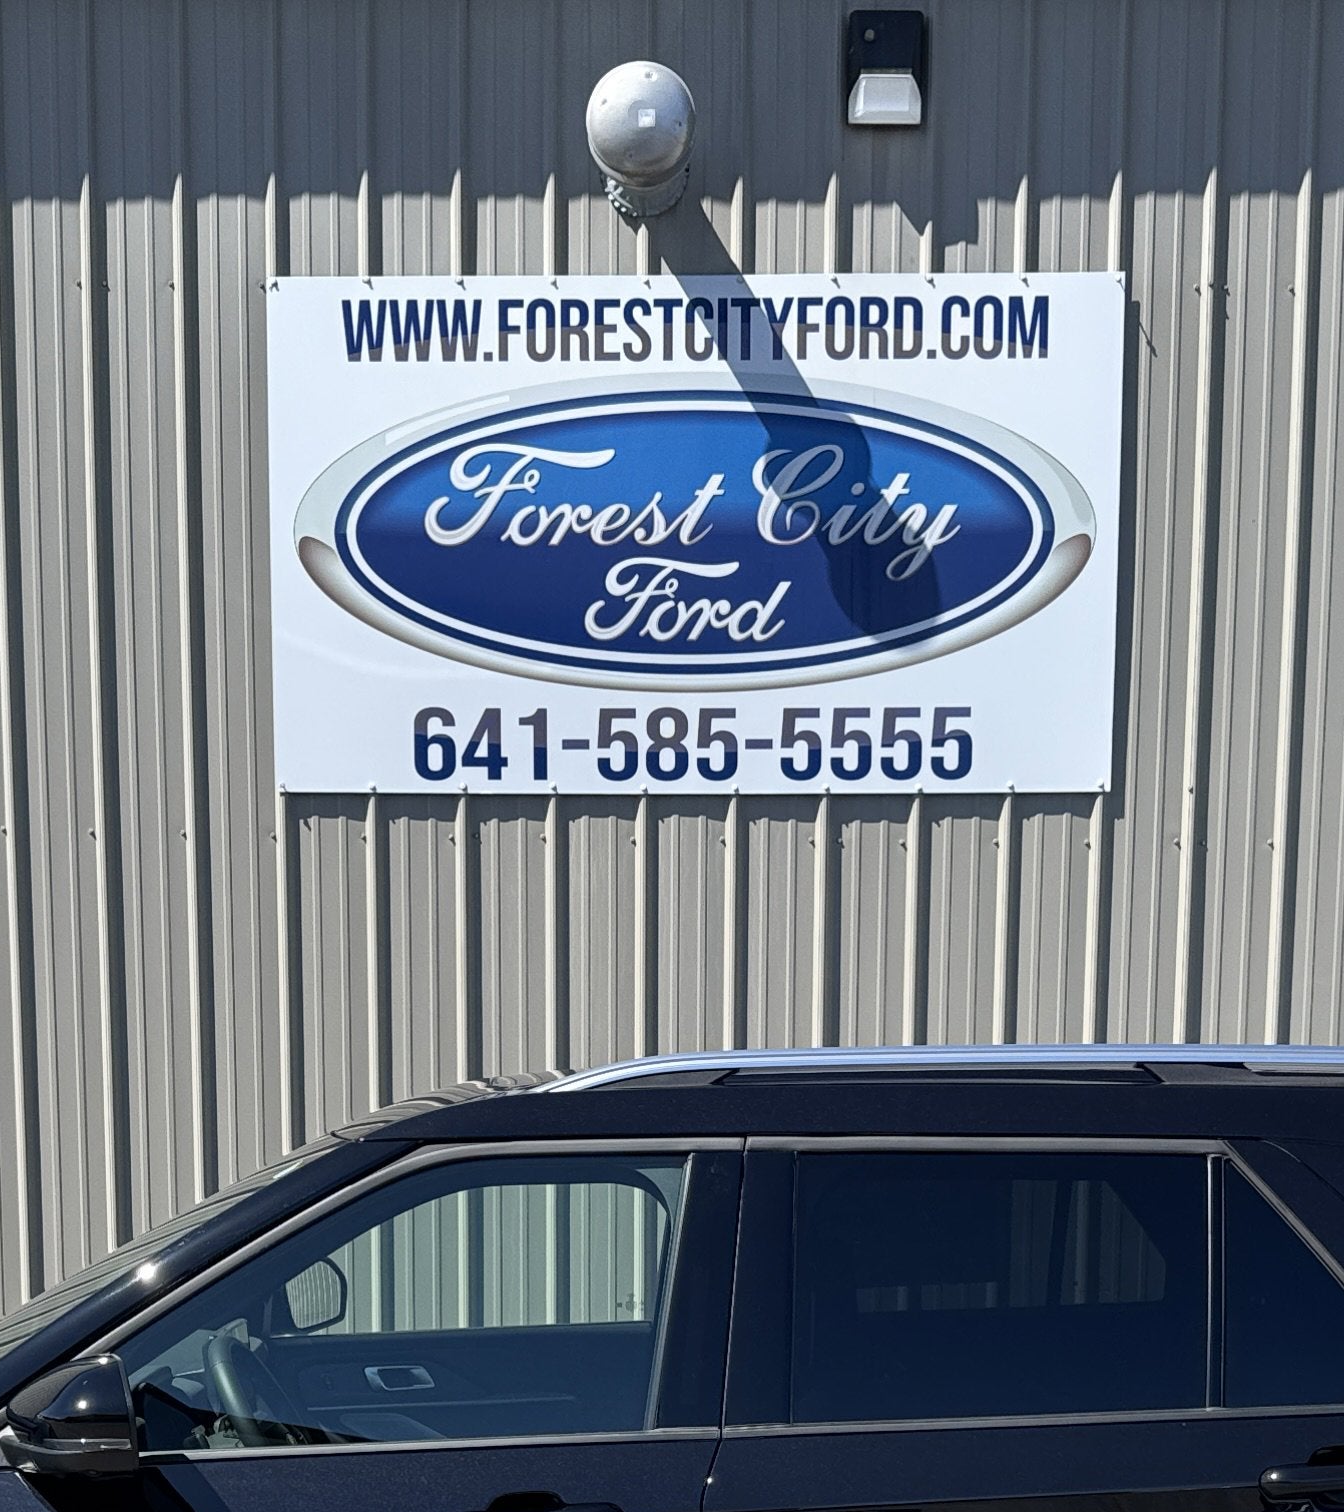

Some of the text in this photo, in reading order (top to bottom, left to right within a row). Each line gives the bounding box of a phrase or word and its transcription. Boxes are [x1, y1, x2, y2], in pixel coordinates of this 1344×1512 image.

[341, 295, 1050, 363] WWW.FORESTCITYFORD.COM
[423, 443, 960, 581] Forest City
[584, 556, 792, 642] Ford
[413, 706, 974, 782] 641-585-5555
